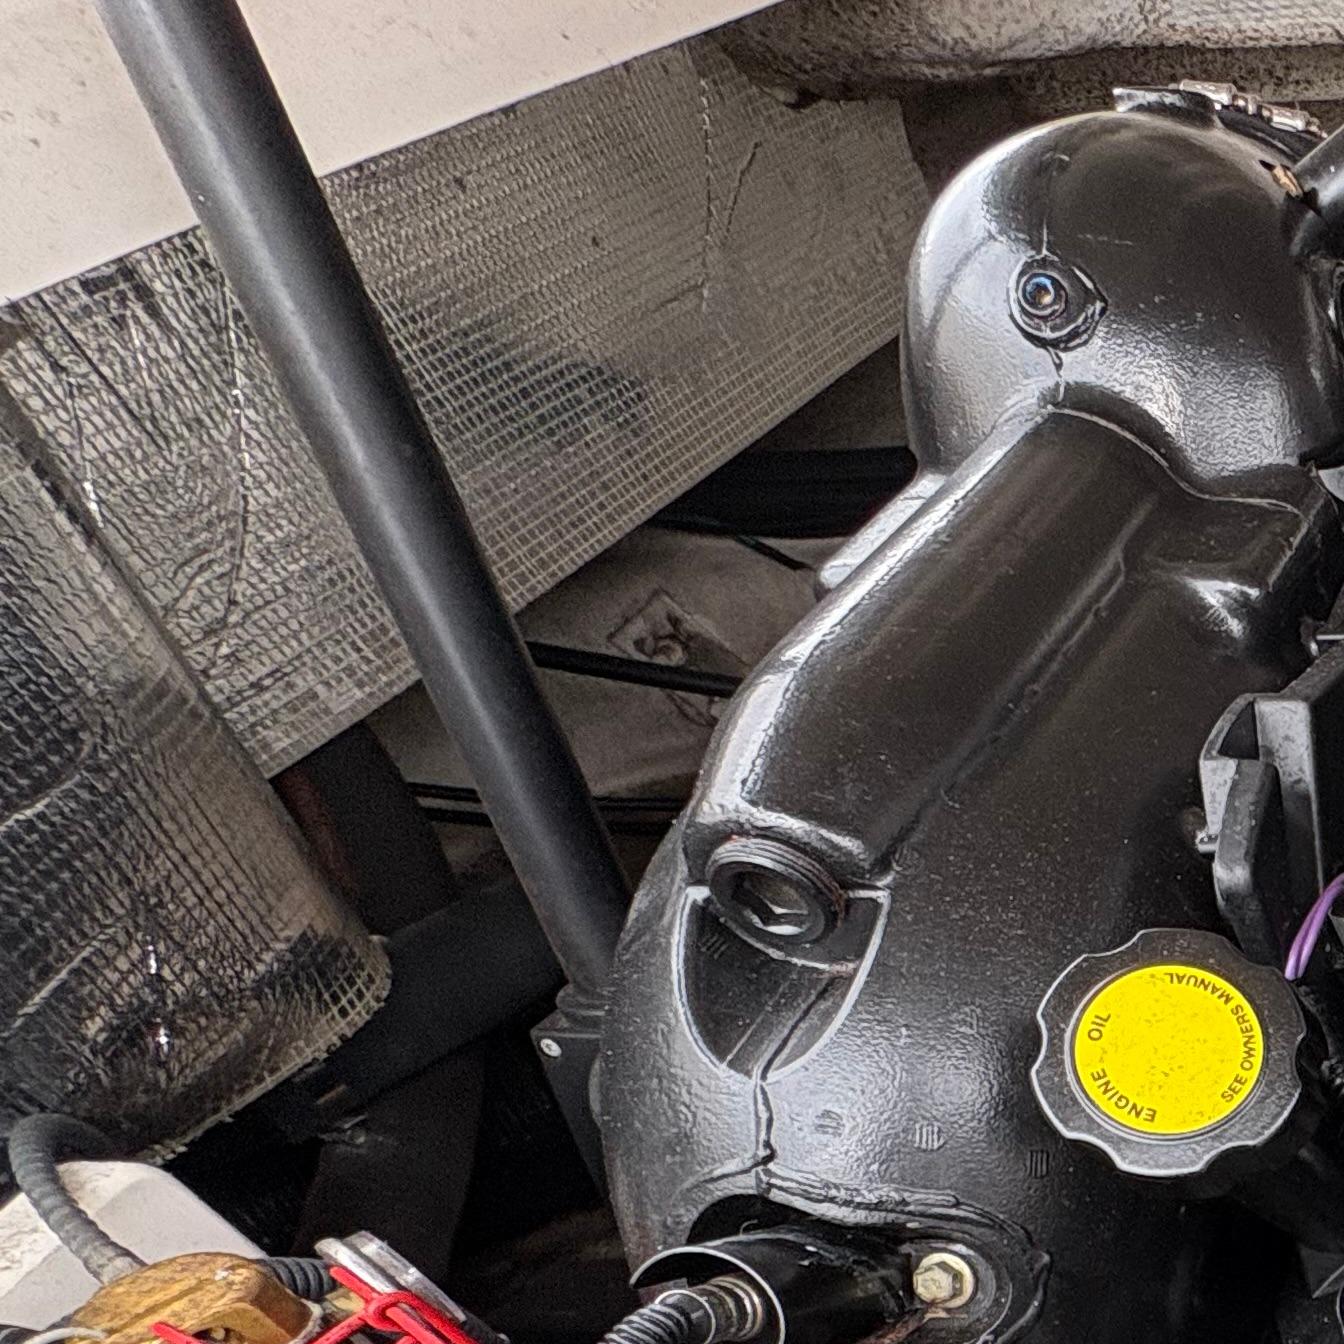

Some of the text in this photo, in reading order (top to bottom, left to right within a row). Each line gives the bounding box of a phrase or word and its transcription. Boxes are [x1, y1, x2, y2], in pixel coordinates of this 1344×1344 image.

[1087, 1012, 1157, 1123] ENGINE OIL
[1164, 971, 1257, 1104] SEE OWNERS MANUAL
